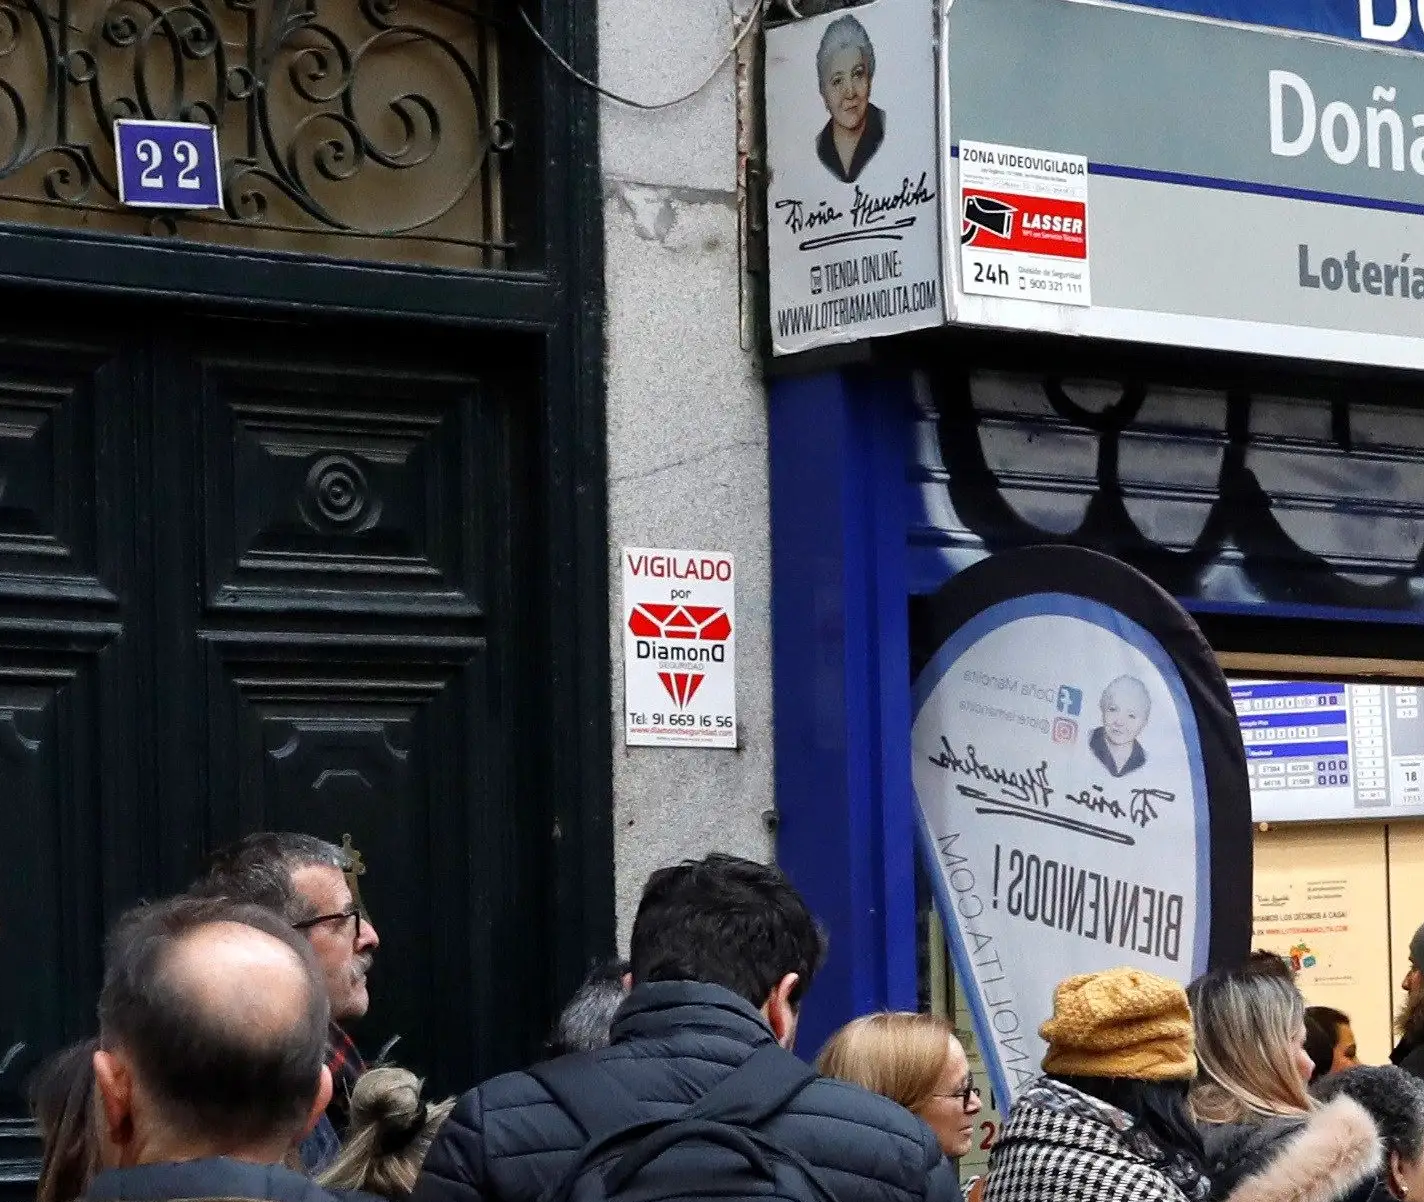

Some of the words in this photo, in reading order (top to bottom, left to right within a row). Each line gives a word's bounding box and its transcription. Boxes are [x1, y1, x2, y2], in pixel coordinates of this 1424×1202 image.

[136, 139, 200, 190] 22
[963, 148, 995, 165] ZONA
[997, 153, 1085, 176] VIDEOVIGILADA
[1021, 213, 1084, 233] LASSER
[825, 259, 859, 292] TIENDA
[862, 250, 902, 284] ONLINE:
[973, 262, 1009, 285] 24h
[777, 280, 937, 337] WWW.LOTERIAMANOLITA.COM
[628, 554, 732, 582] VIGILADO
[671, 588, 692, 600] por
[652, 713, 664, 725] 91
[669, 714, 695, 726] 669
[699, 715, 711, 727] 16
[715, 716, 733, 728] 56
